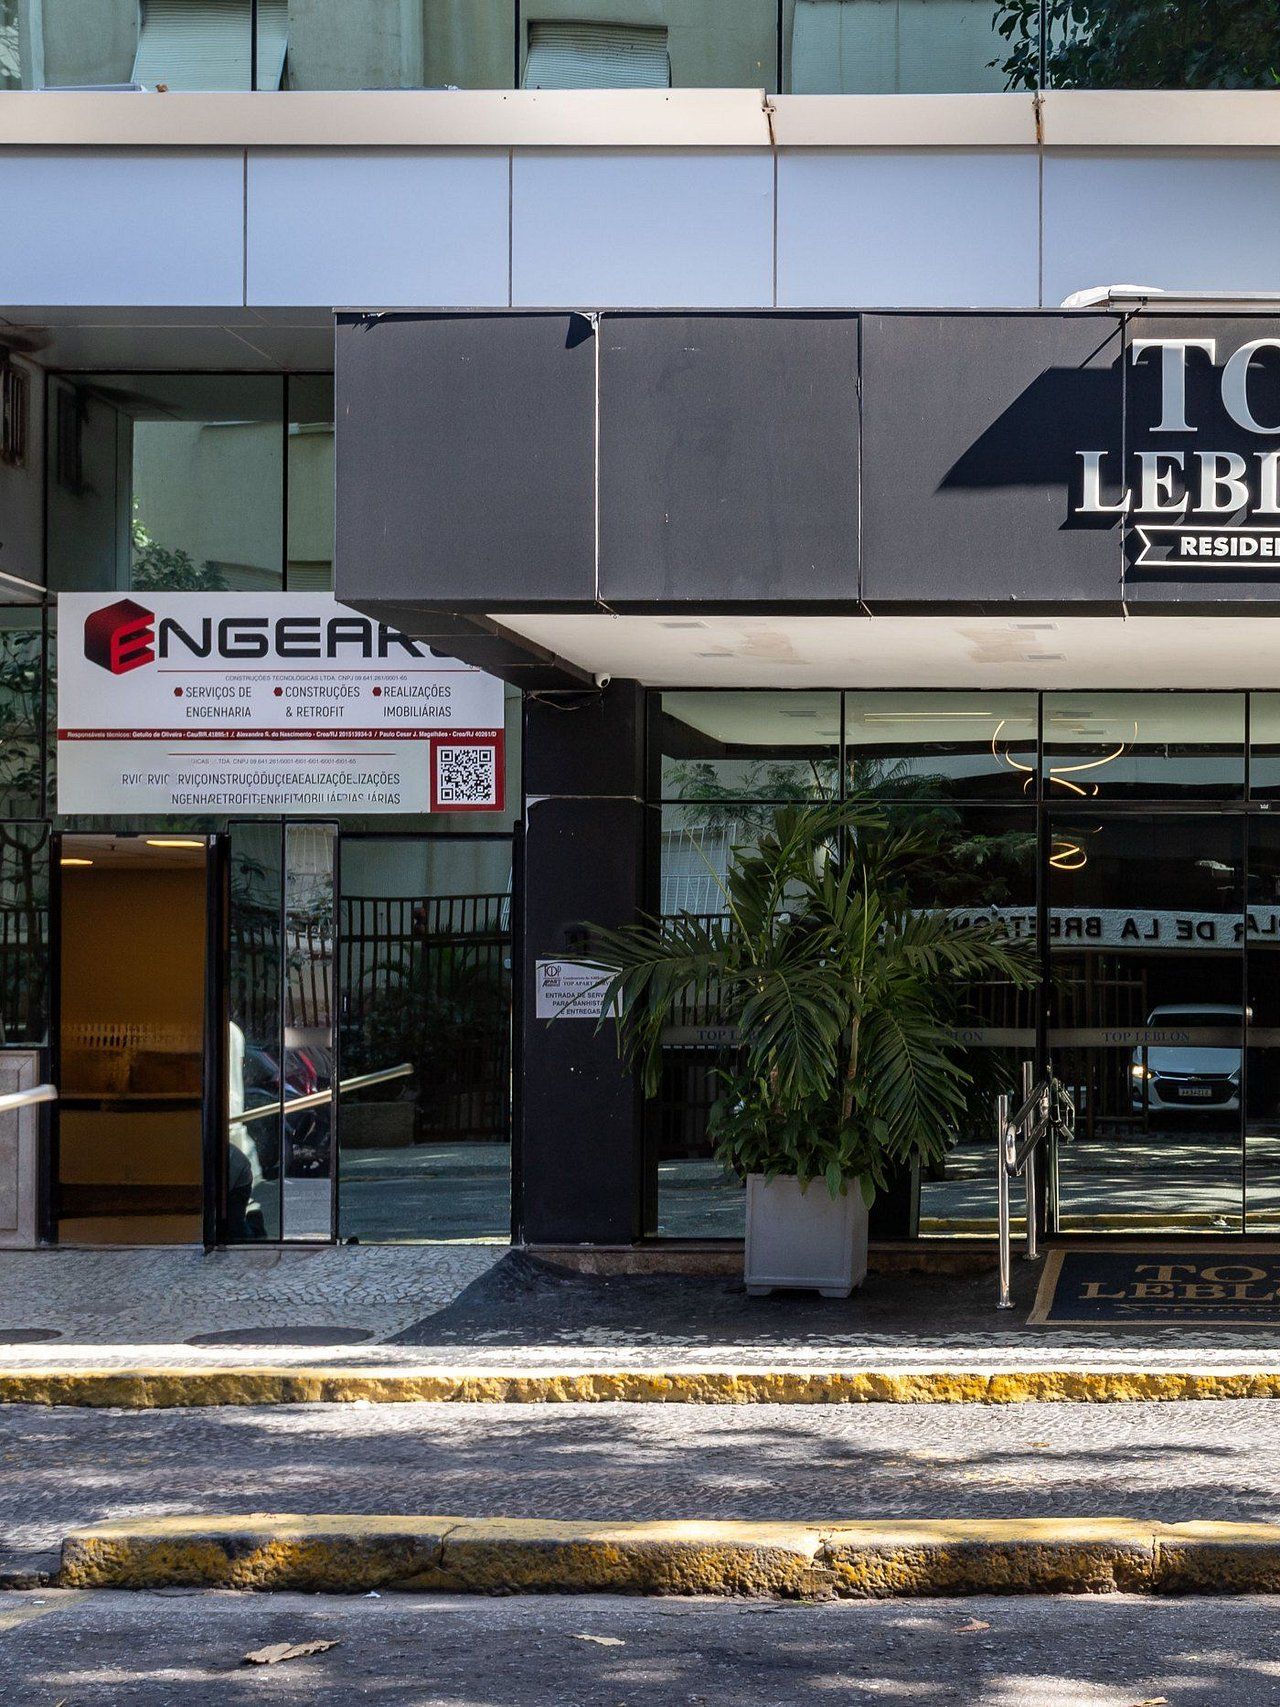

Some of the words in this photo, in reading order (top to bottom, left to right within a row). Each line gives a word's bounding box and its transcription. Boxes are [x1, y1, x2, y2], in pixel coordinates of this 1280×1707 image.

[185, 686, 236, 701] SERVIÇOS
[238, 686, 252, 698] DE
[285, 684, 360, 701] CONSTRUÇÕES
[384, 684, 451, 701] REALIZAÇÕES
[186, 706, 252, 718] ENGENHARIA
[285, 706, 293, 718] &
[297, 706, 345, 718] RETROFIT
[383, 704, 452, 718] IMOBILIÁRIAS
[1102, 1031, 1132, 1041] TOP
[1134, 1031, 1189, 1041] LEBLON
